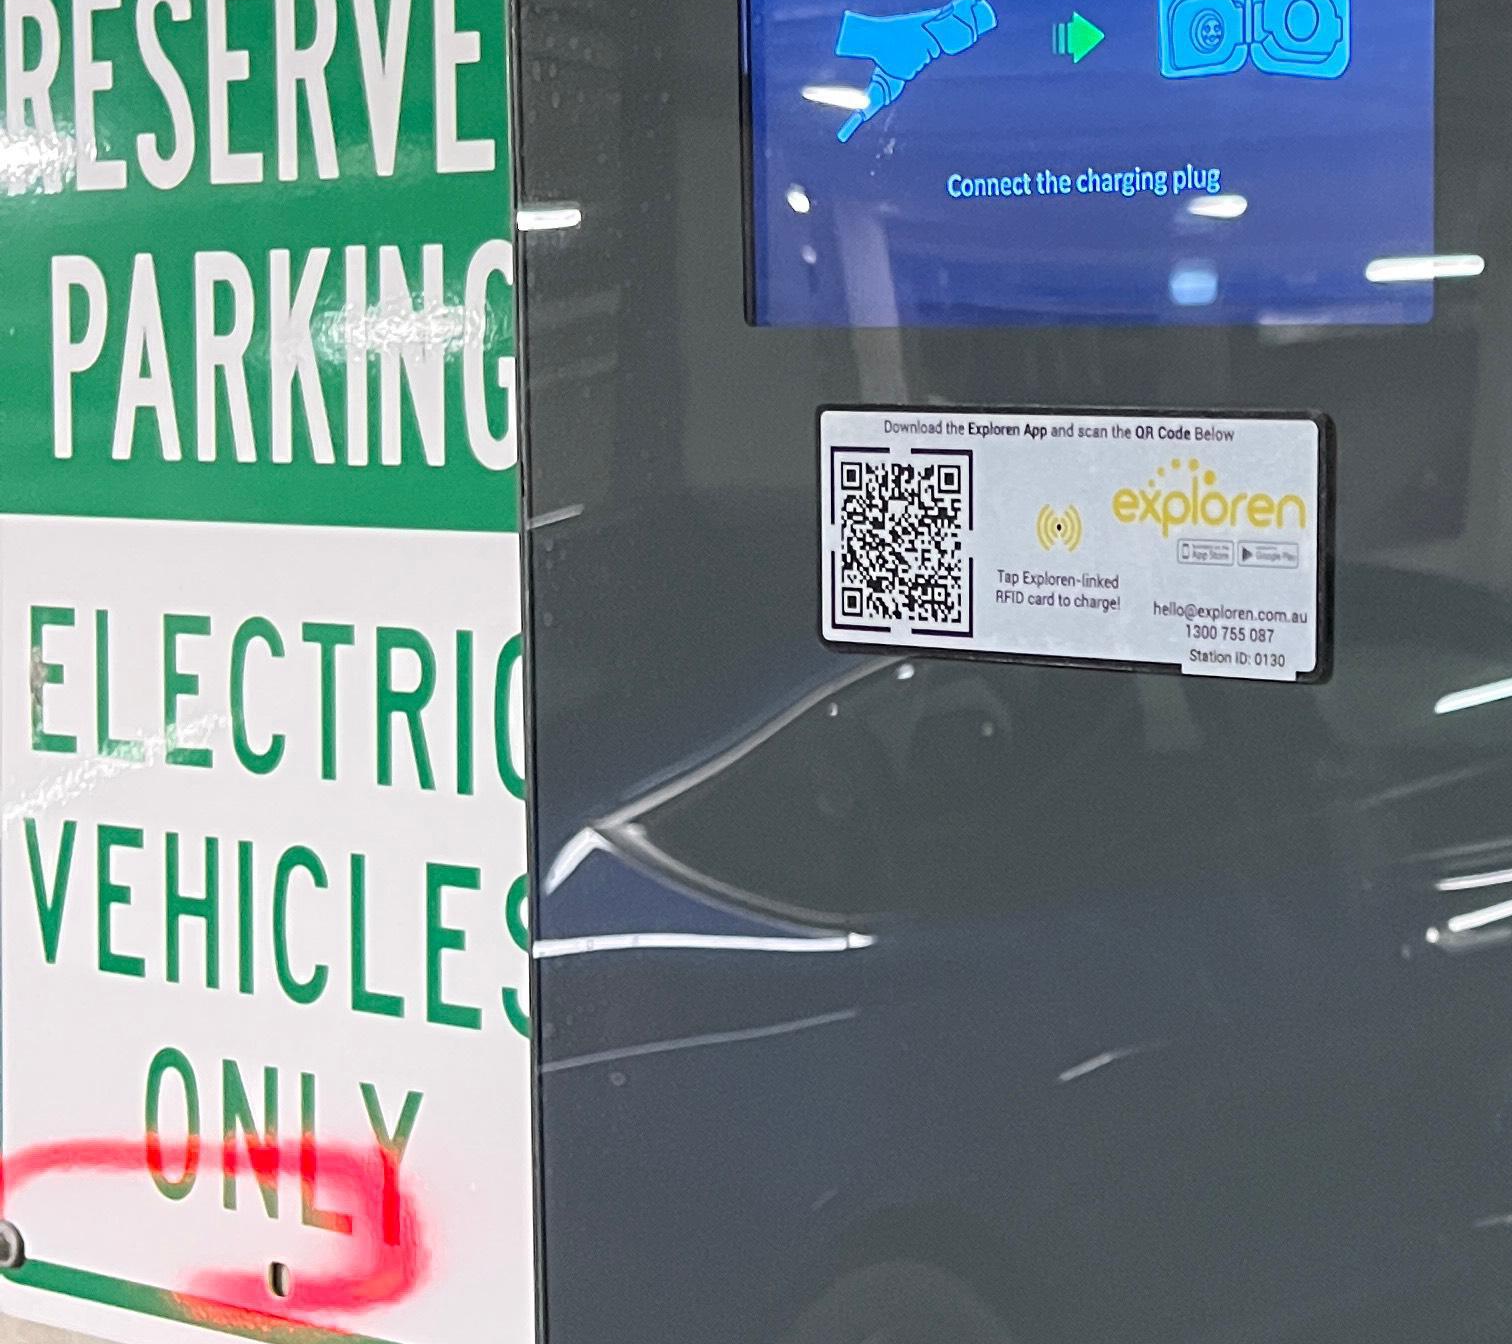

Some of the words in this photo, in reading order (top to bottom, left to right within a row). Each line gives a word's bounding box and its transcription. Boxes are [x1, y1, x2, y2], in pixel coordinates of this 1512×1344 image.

[948, 172, 1033, 198] Connect
[1036, 169, 1071, 195] the
[1075, 167, 1168, 197] charging
[1172, 163, 1221, 195] plug
[51, 238, 518, 471] PARKING
[883, 419, 943, 435] Download
[945, 422, 965, 436] the
[968, 421, 1020, 439] Exploren
[1023, 423, 1048, 440] App
[1050, 423, 1075, 438] and
[1077, 425, 1108, 439] scan
[1111, 425, 1132, 440] the
[1135, 426, 1154, 441] QR
[1157, 426, 1191, 441] Code
[1194, 426, 1235, 442] Below
[1111, 475, 1307, 539] exploren
[997, 569, 1019, 586] Tap
[1022, 570, 1120, 590] Exploren-linked
[995, 589, 1025, 605] RFID
[1027, 592, 1055, 606] card
[1057, 594, 1071, 608] to
[1073, 594, 1121, 613] charge!
[1152, 600, 1308, 624] hello@exploren.com.au
[1186, 623, 1218, 640] 1300
[1221, 626, 1246, 642] 755
[1249, 628, 1275, 644] 087
[1189, 648, 1232, 664] Station
[1235, 651, 1252, 666] ID:
[1254, 652, 1286, 668] 0130
[143, 1046, 424, 1247] ONLY
